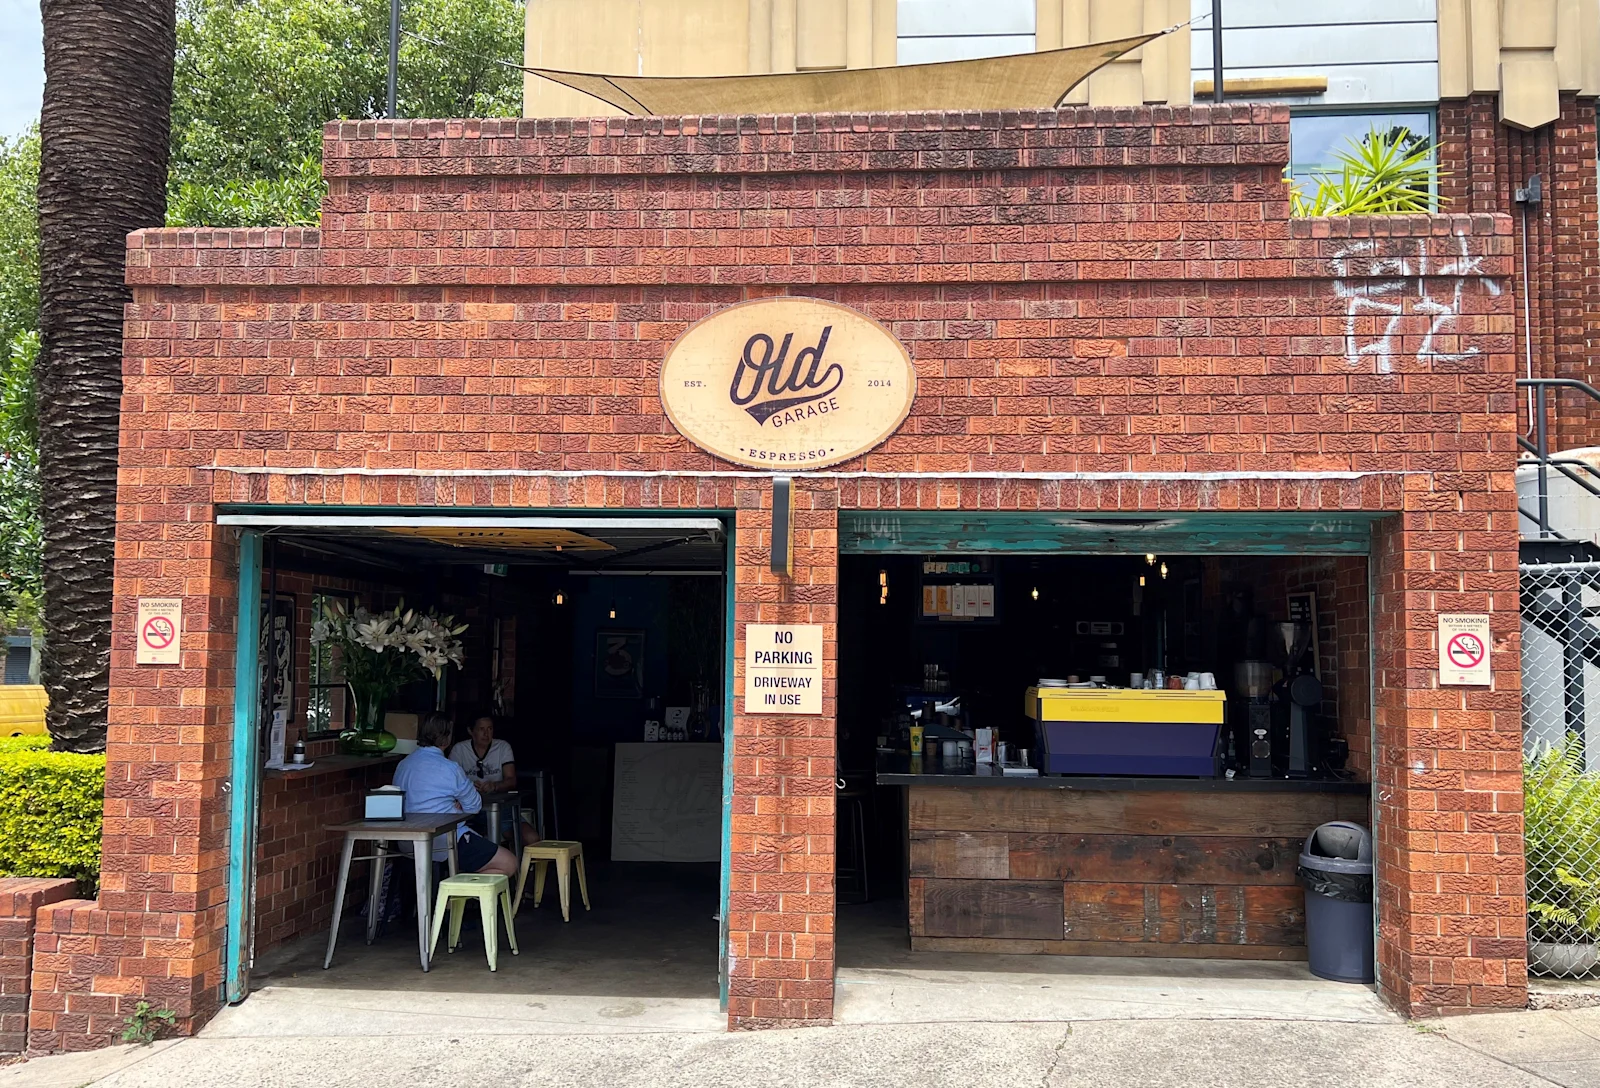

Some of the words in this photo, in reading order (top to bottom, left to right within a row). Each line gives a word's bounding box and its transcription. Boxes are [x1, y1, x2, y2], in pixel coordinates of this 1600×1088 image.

[730, 325, 844, 406] Old
[683, 380, 707, 388] EST.
[867, 379, 892, 387] 2014
[771, 397, 840, 428] GARAGE
[749, 448, 827, 461] ESPRESSO
[774, 631, 793, 644] NO
[754, 650, 813, 664] PARKING
[754, 676, 812, 688] DRIVEWAY
[764, 694, 776, 705] IN
[779, 694, 801, 705] USE
